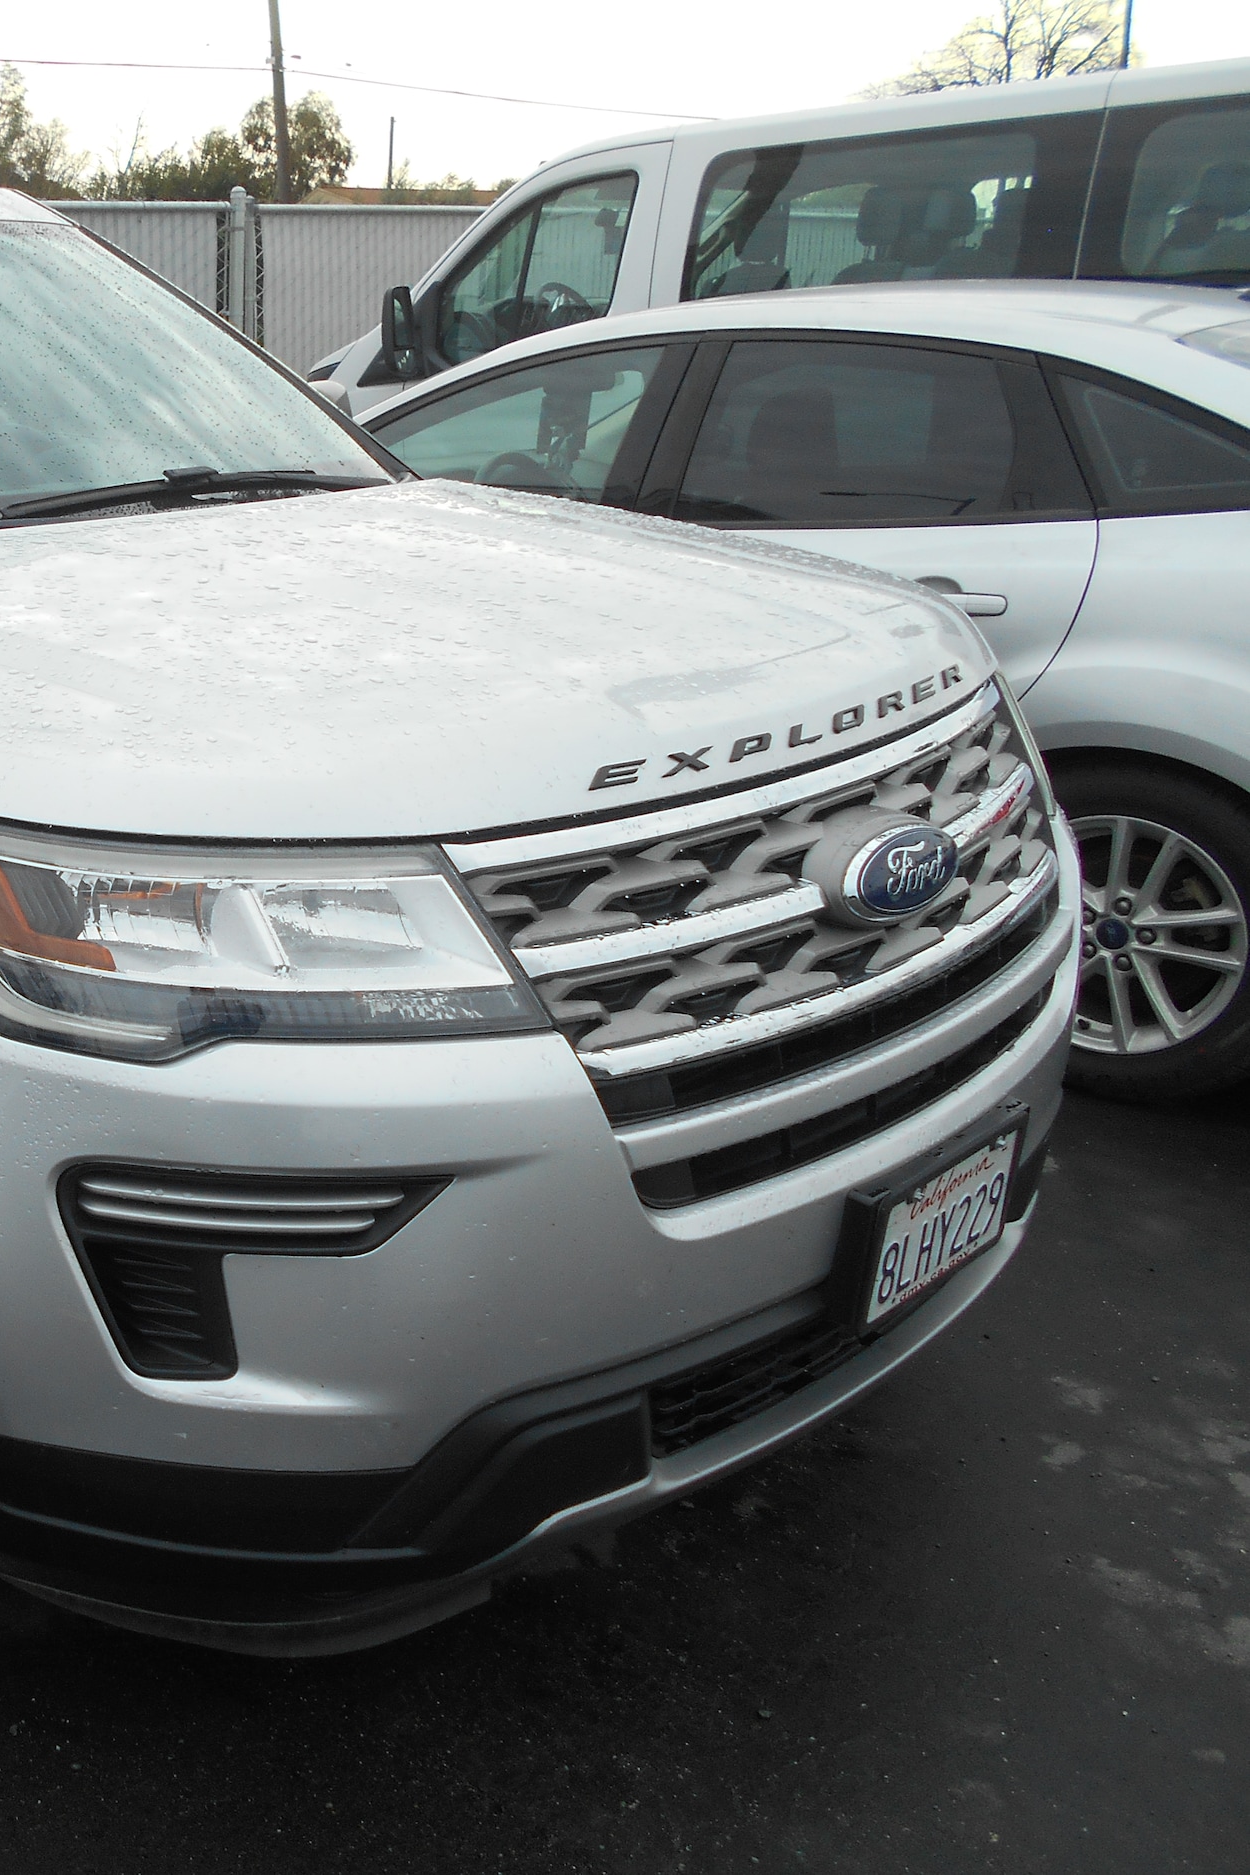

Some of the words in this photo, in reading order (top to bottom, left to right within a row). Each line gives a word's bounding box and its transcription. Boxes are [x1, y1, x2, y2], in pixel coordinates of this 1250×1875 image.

[588, 663, 964, 790] EXPLORER
[886, 840, 946, 895] Ford
[910, 1156, 995, 1220] California
[877, 1172, 1005, 1304] 8LHY229
